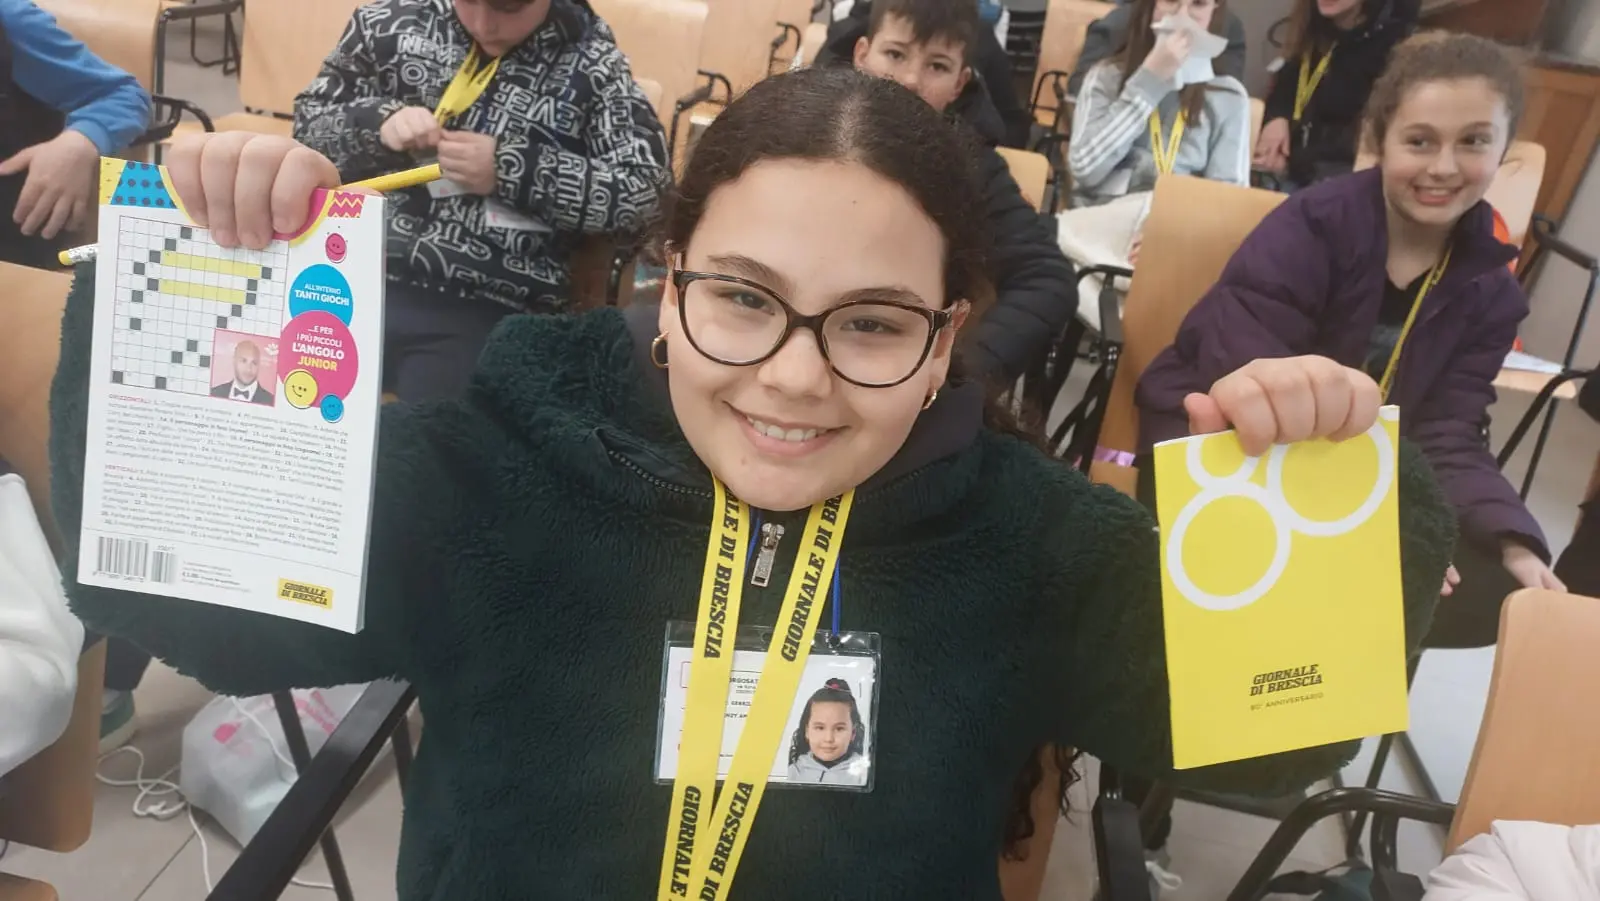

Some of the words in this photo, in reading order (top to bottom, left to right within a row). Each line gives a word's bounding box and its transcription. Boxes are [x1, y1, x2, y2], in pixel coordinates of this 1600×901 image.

[294, 289, 320, 301] TANTI
[320, 294, 349, 306] GIOCHI
[300, 332, 312, 342] PIÙ
[314, 335, 342, 347] PICCOLI
[320, 326, 333, 335] PER
[292, 342, 344, 360] L'ANGOLO
[297, 355, 338, 371] JUNIOR
[717, 533, 736, 561] DI
[281, 589, 291, 597] DI
[292, 591, 328, 606] BRESCIA
[284, 582, 327, 597] GIORNALE
[780, 553, 825, 662] GIORNALE
[814, 525, 833, 553] DI
[703, 563, 733, 659] BRESCIA
[1253, 663, 1319, 685] GIORNALE
[1249, 684, 1264, 697] DI
[1267, 673, 1323, 694] BRESCIA
[1265, 692, 1324, 707] ANNIVERSARIO
[708, 782, 754, 877] BRESCIA
[670, 785, 701, 898] GIORNALE
[699, 875, 720, 901] DI
